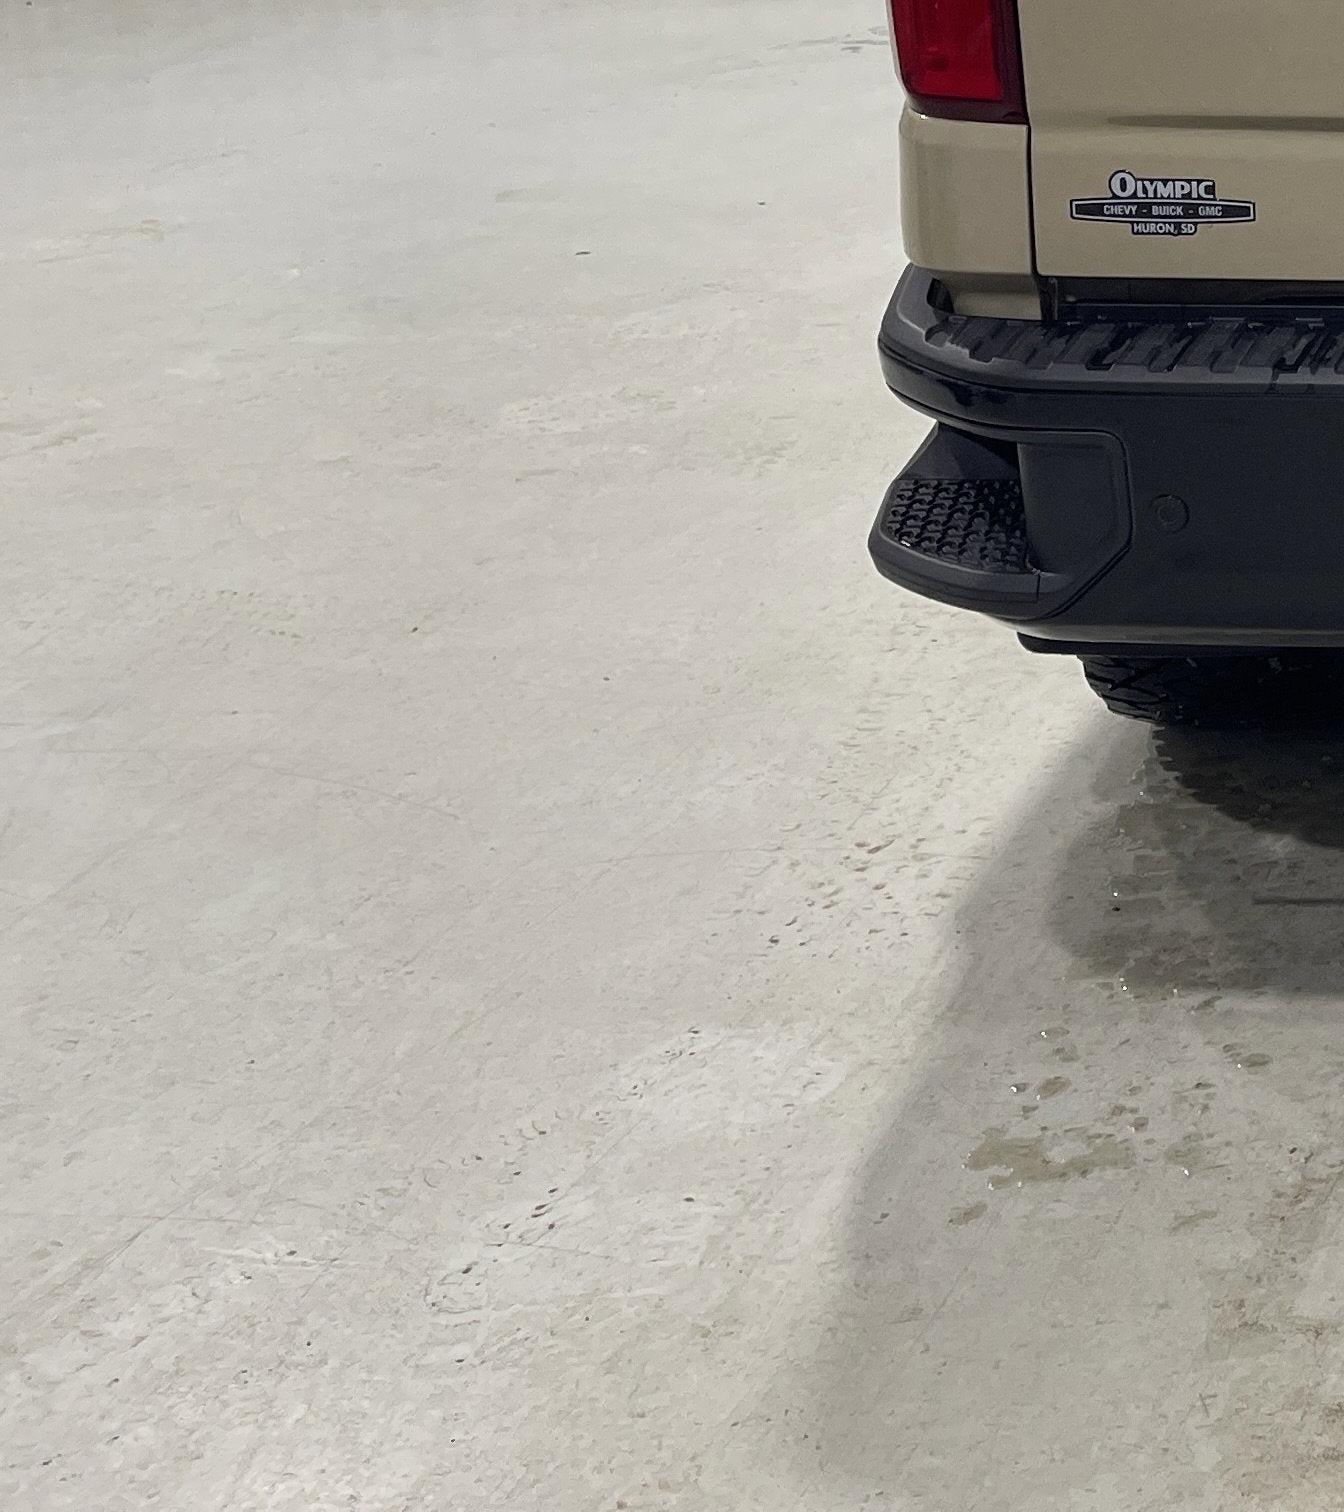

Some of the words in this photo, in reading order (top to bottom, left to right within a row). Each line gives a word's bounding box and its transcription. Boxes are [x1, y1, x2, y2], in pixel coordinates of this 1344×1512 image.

[1103, 205, 1137, 215] CHEVY
[1152, 205, 1184, 216] BUICK
[1198, 206, 1222, 216] GMC
[1134, 223, 1178, 234] HURON,
[1181, 224, 1195, 233] SD
